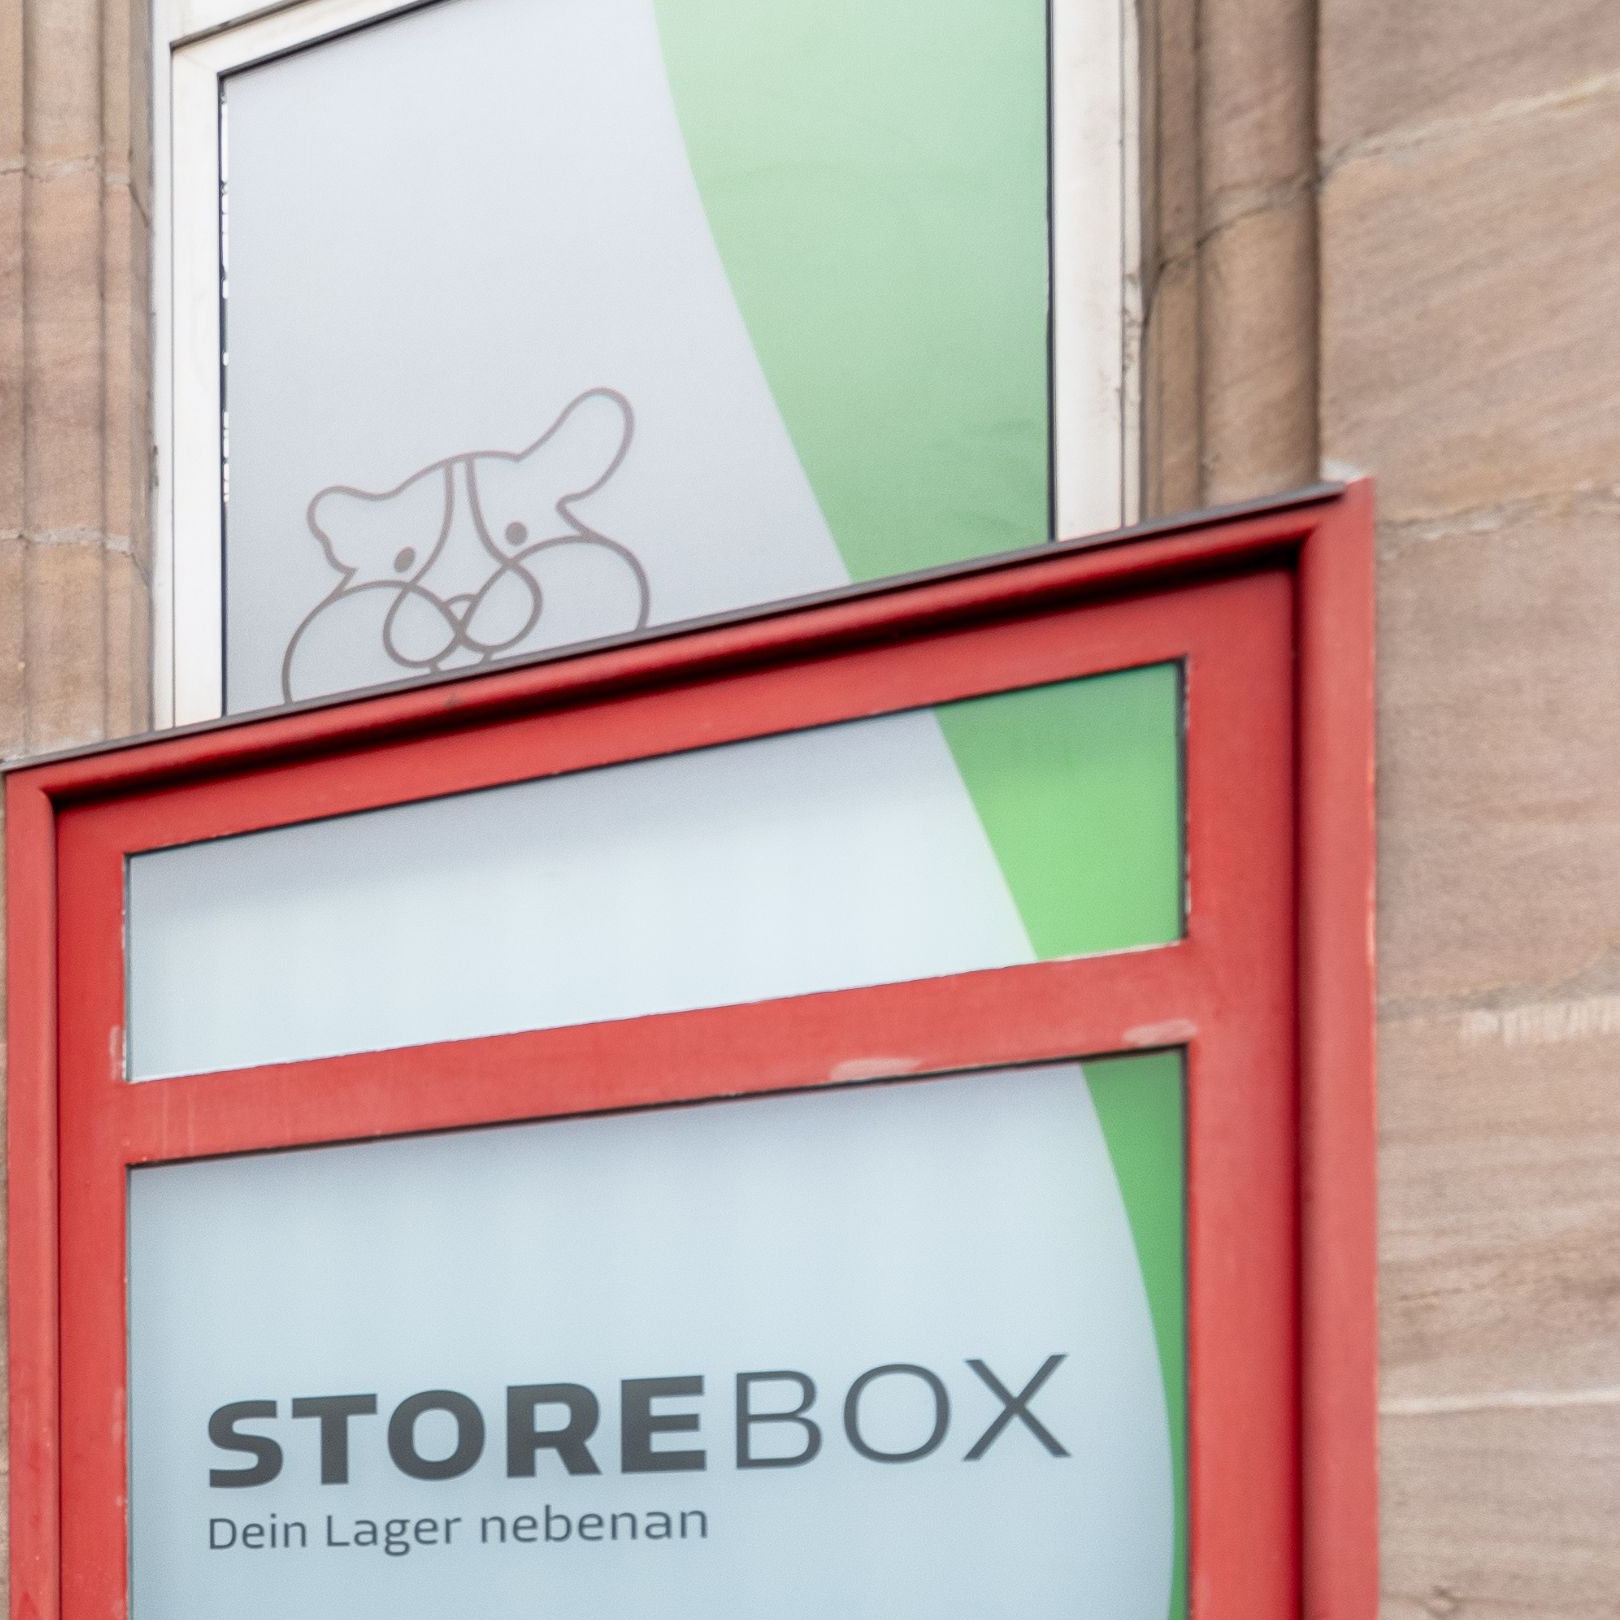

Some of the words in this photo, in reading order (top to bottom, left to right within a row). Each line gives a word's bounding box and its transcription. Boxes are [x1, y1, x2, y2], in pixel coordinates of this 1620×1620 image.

[206, 1352, 1073, 1489] STOREBOX
[207, 1513, 310, 1551] Dein
[325, 1510, 463, 1557] Lager
[479, 1502, 709, 1545] nebenan
